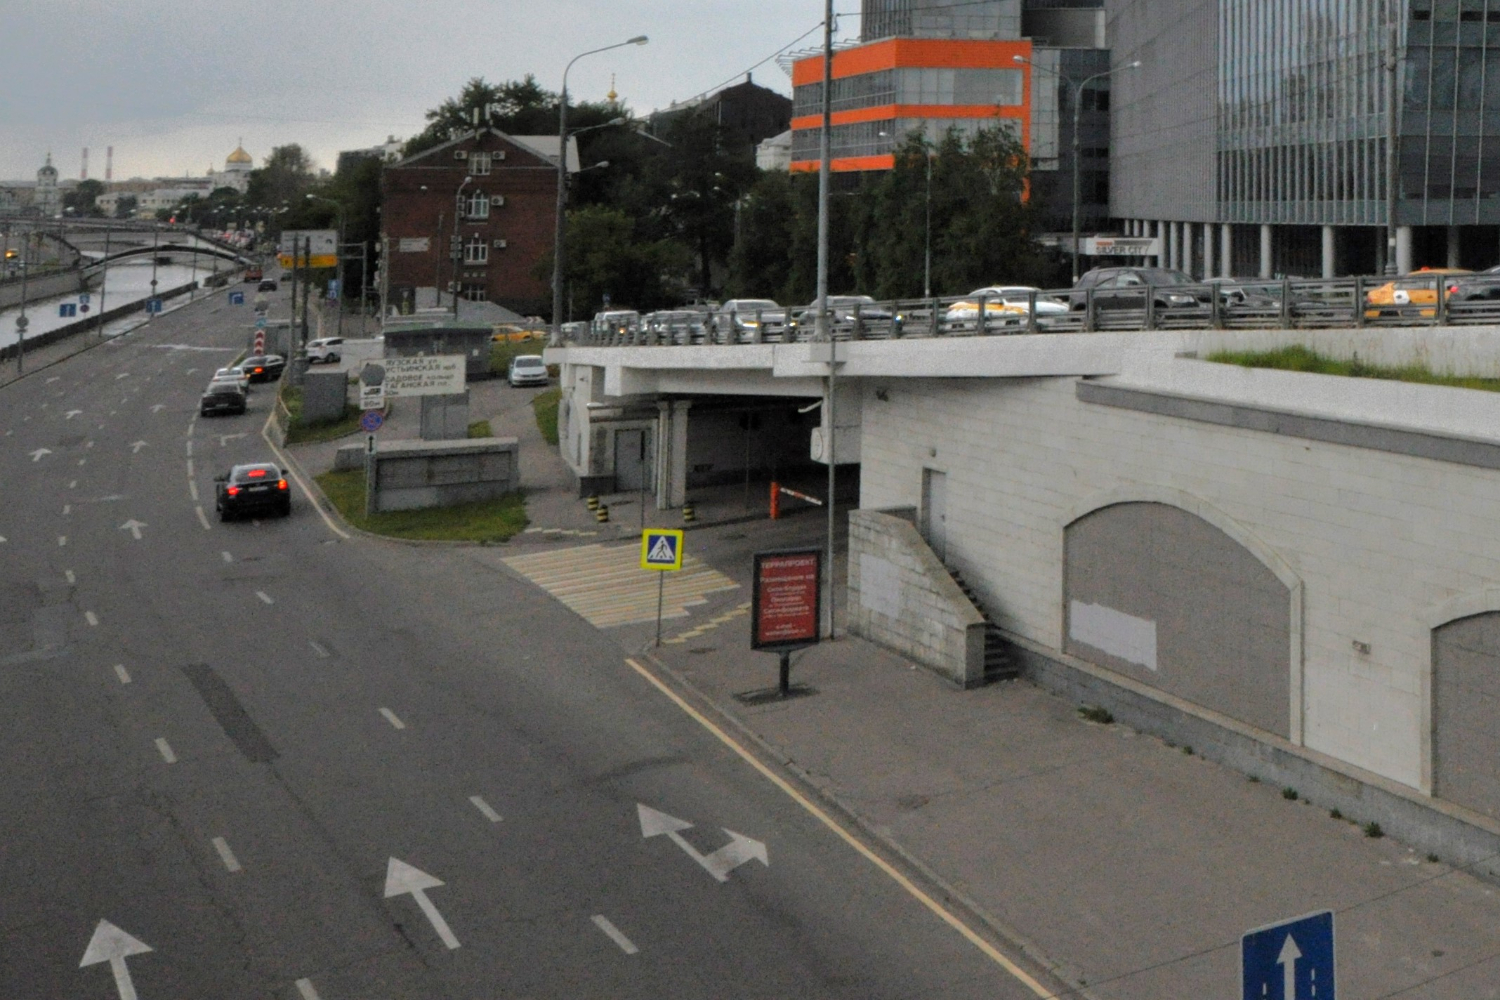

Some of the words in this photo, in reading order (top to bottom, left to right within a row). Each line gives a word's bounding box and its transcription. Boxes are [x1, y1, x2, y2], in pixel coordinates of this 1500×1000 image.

[1096, 246, 1126, 254] SILVER
[385, 358, 424, 366] ЯУЗСКАЯ
[385, 364, 441, 373] УСТЬИНСКАЯ
[385, 374, 423, 382] САДОВОЕ
[384, 380, 435, 389] ТАГАНСКАЯ
